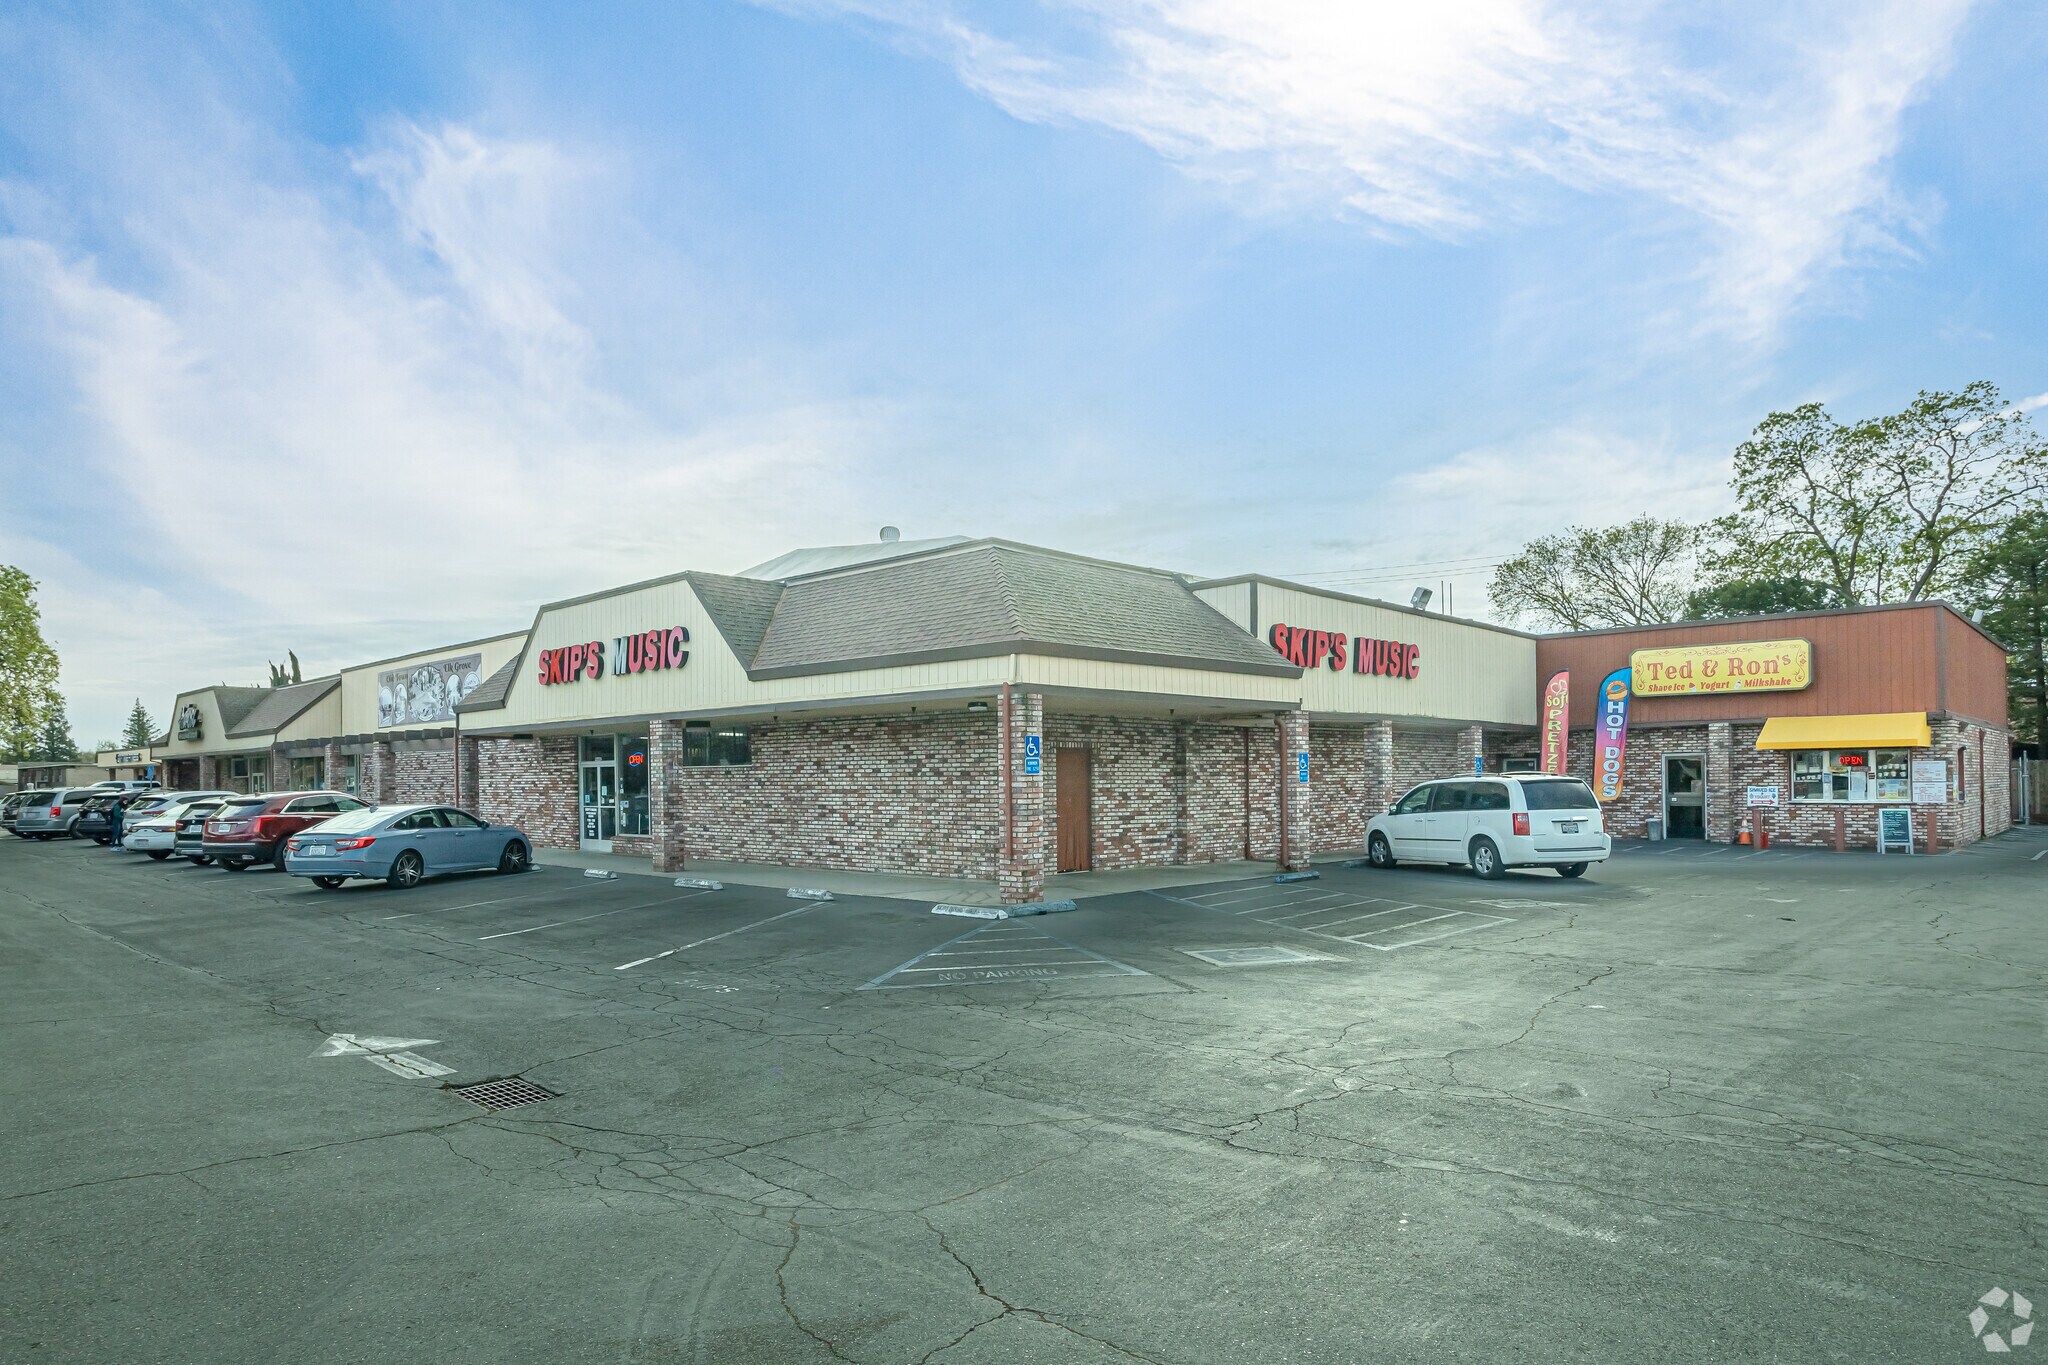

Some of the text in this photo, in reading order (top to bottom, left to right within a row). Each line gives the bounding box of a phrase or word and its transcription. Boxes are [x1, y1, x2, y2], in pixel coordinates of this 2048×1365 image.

[538, 626, 690, 686] SKIP'S MUSIC
[1269, 623, 1420, 680] SKIP'S MUSIC
[443, 663, 454, 673] Elk
[454, 661, 472, 672] Grove
[1647, 654, 1792, 681] Ted & Ron's
[1648, 677, 1792, 693] Shave Ice Yogurt Milkshake
[1547, 709, 1563, 772] PRETZE
[1601, 701, 1624, 797] HOT DOGS
[628, 754, 644, 764] OPEN
[1838, 755, 1863, 765] OPEN
[938, 968, 1058, 981] NO PARKING
